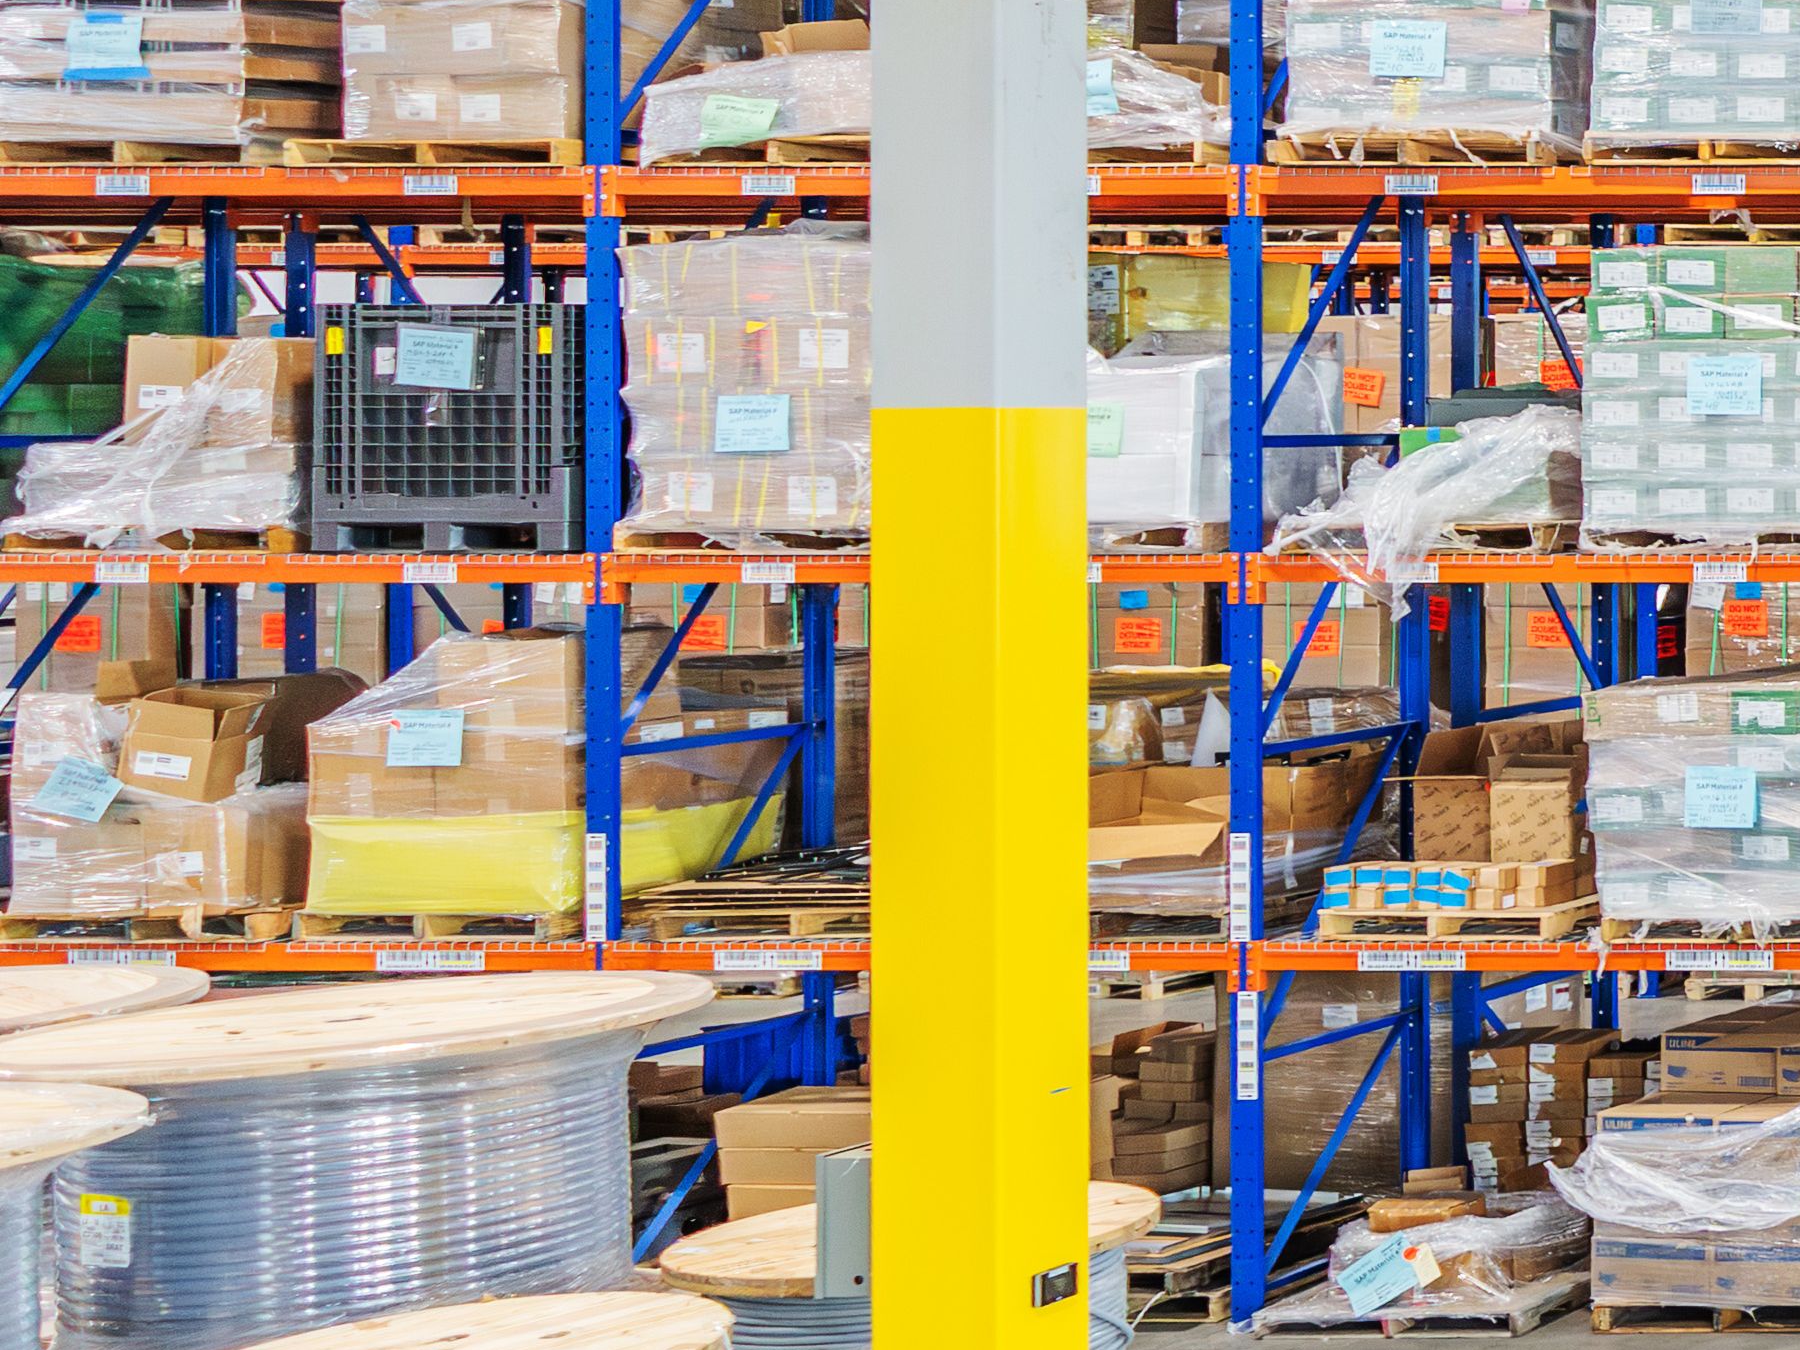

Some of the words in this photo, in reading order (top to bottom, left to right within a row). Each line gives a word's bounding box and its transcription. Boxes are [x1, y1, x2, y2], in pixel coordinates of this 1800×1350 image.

[1728, 605, 1742, 613] DO
[1743, 605, 1761, 613] NOT
[1669, 1038, 1697, 1049] ULINE
[1604, 1119, 1633, 1130] ULINE
